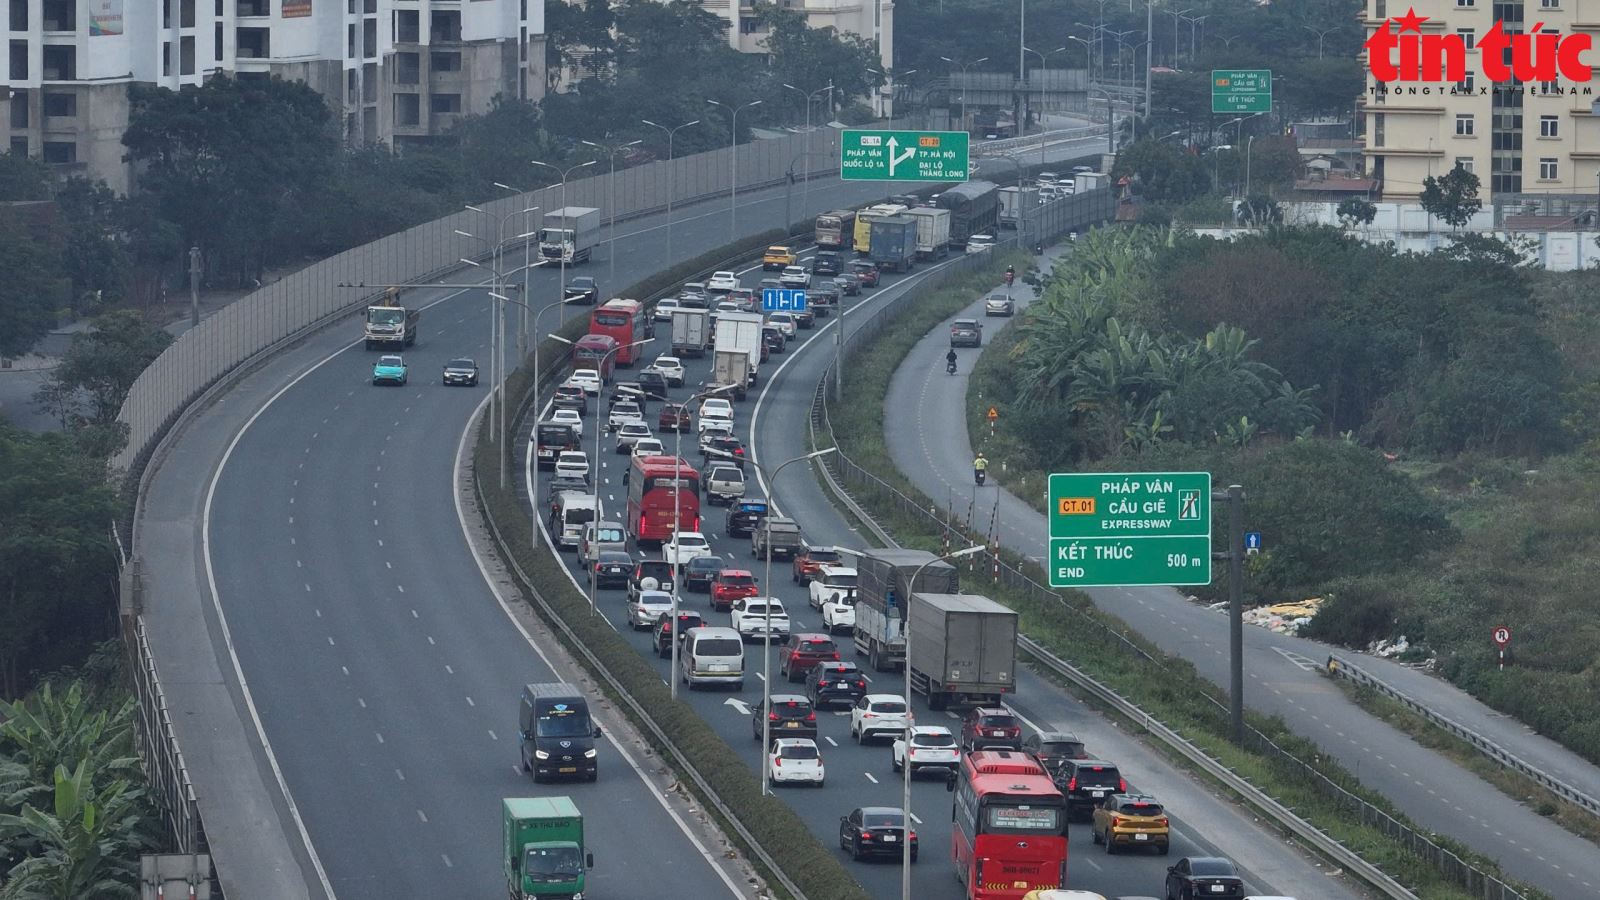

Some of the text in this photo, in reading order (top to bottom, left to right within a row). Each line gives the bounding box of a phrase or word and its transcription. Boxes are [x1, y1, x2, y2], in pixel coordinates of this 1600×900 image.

[847, 149, 865, 157] PHÁP
[943, 151, 956, 159] NỘI
[843, 159, 863, 167] QUỐC
[865, 159, 874, 168] LỘ
[934, 161, 943, 169] LỘ
[1102, 478, 1173, 494] PHÁP VÂN
[1063, 500, 1092, 512] CT.01
[1109, 497, 1166, 514] CẦU GIẼ
[1102, 520, 1172, 529] EXPRESSWAY
[1058, 541, 1133, 560] KẾT THÚC
[1167, 554, 1200, 567] 500 m
[1058, 568, 1084, 578] END
